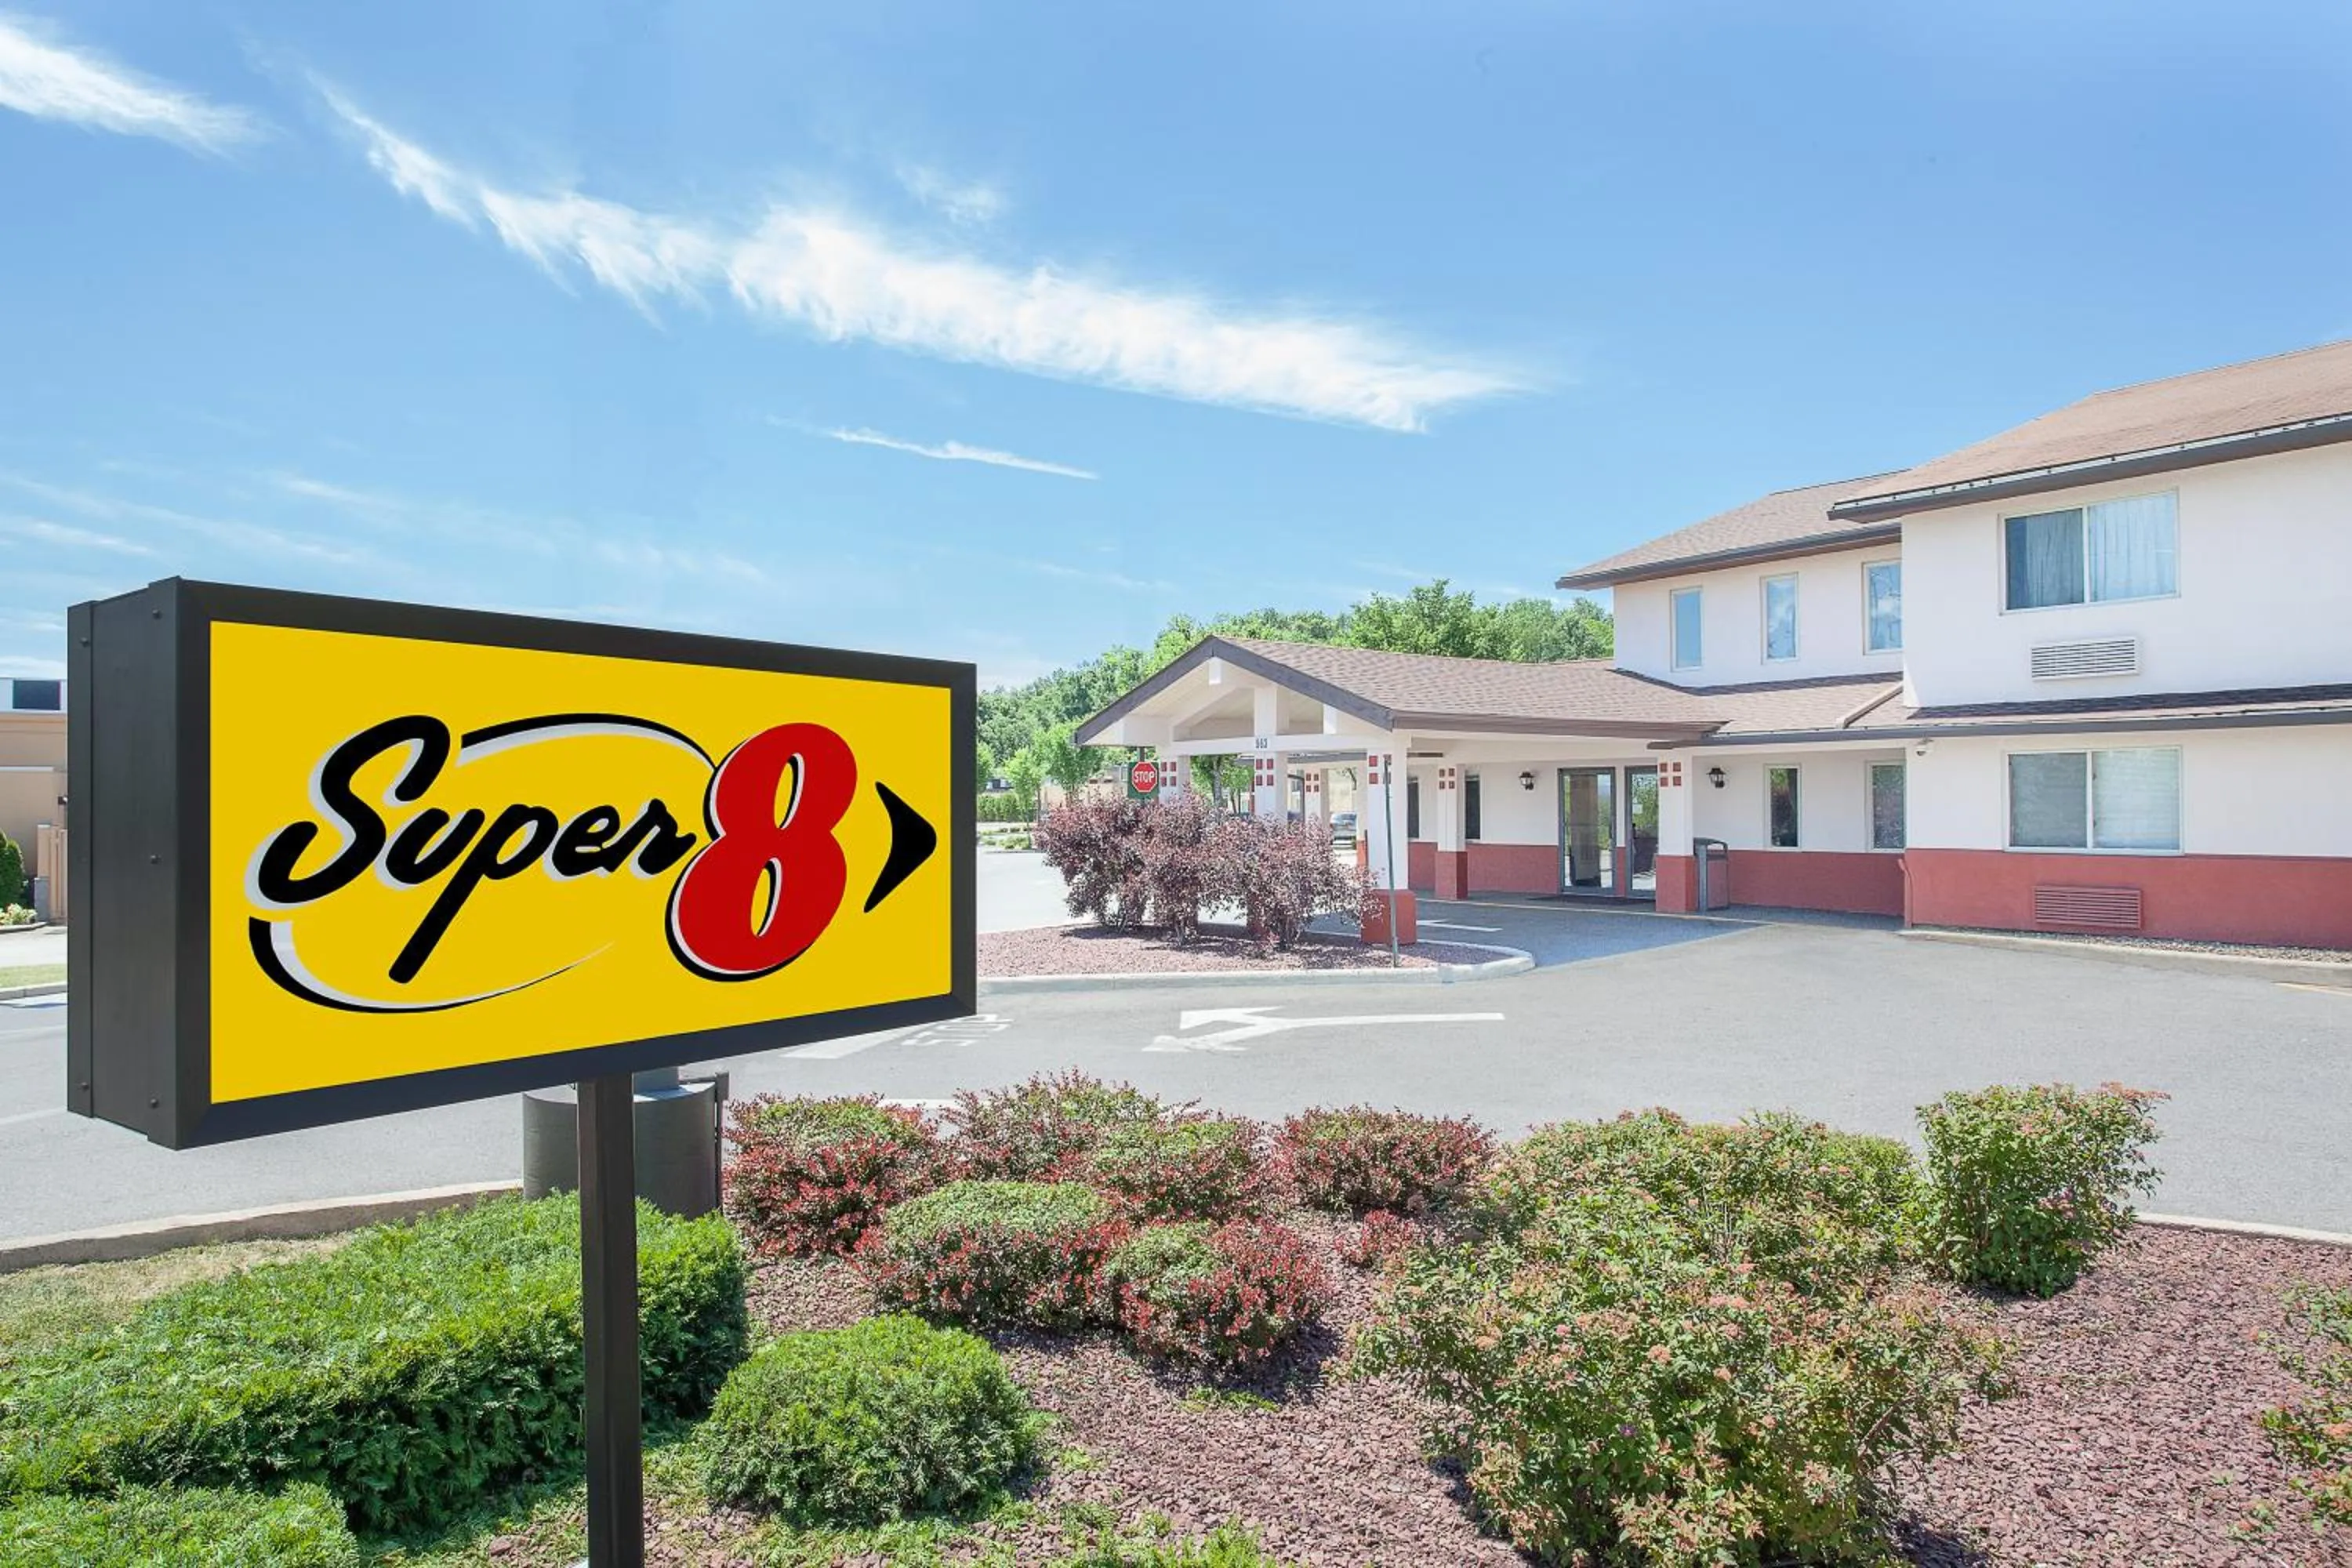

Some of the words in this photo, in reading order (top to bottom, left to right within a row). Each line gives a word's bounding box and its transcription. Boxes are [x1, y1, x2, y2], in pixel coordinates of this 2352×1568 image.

[1134, 771, 1155, 783] STOP
[245, 714, 697, 984] Super
[665, 722, 857, 982] 8
